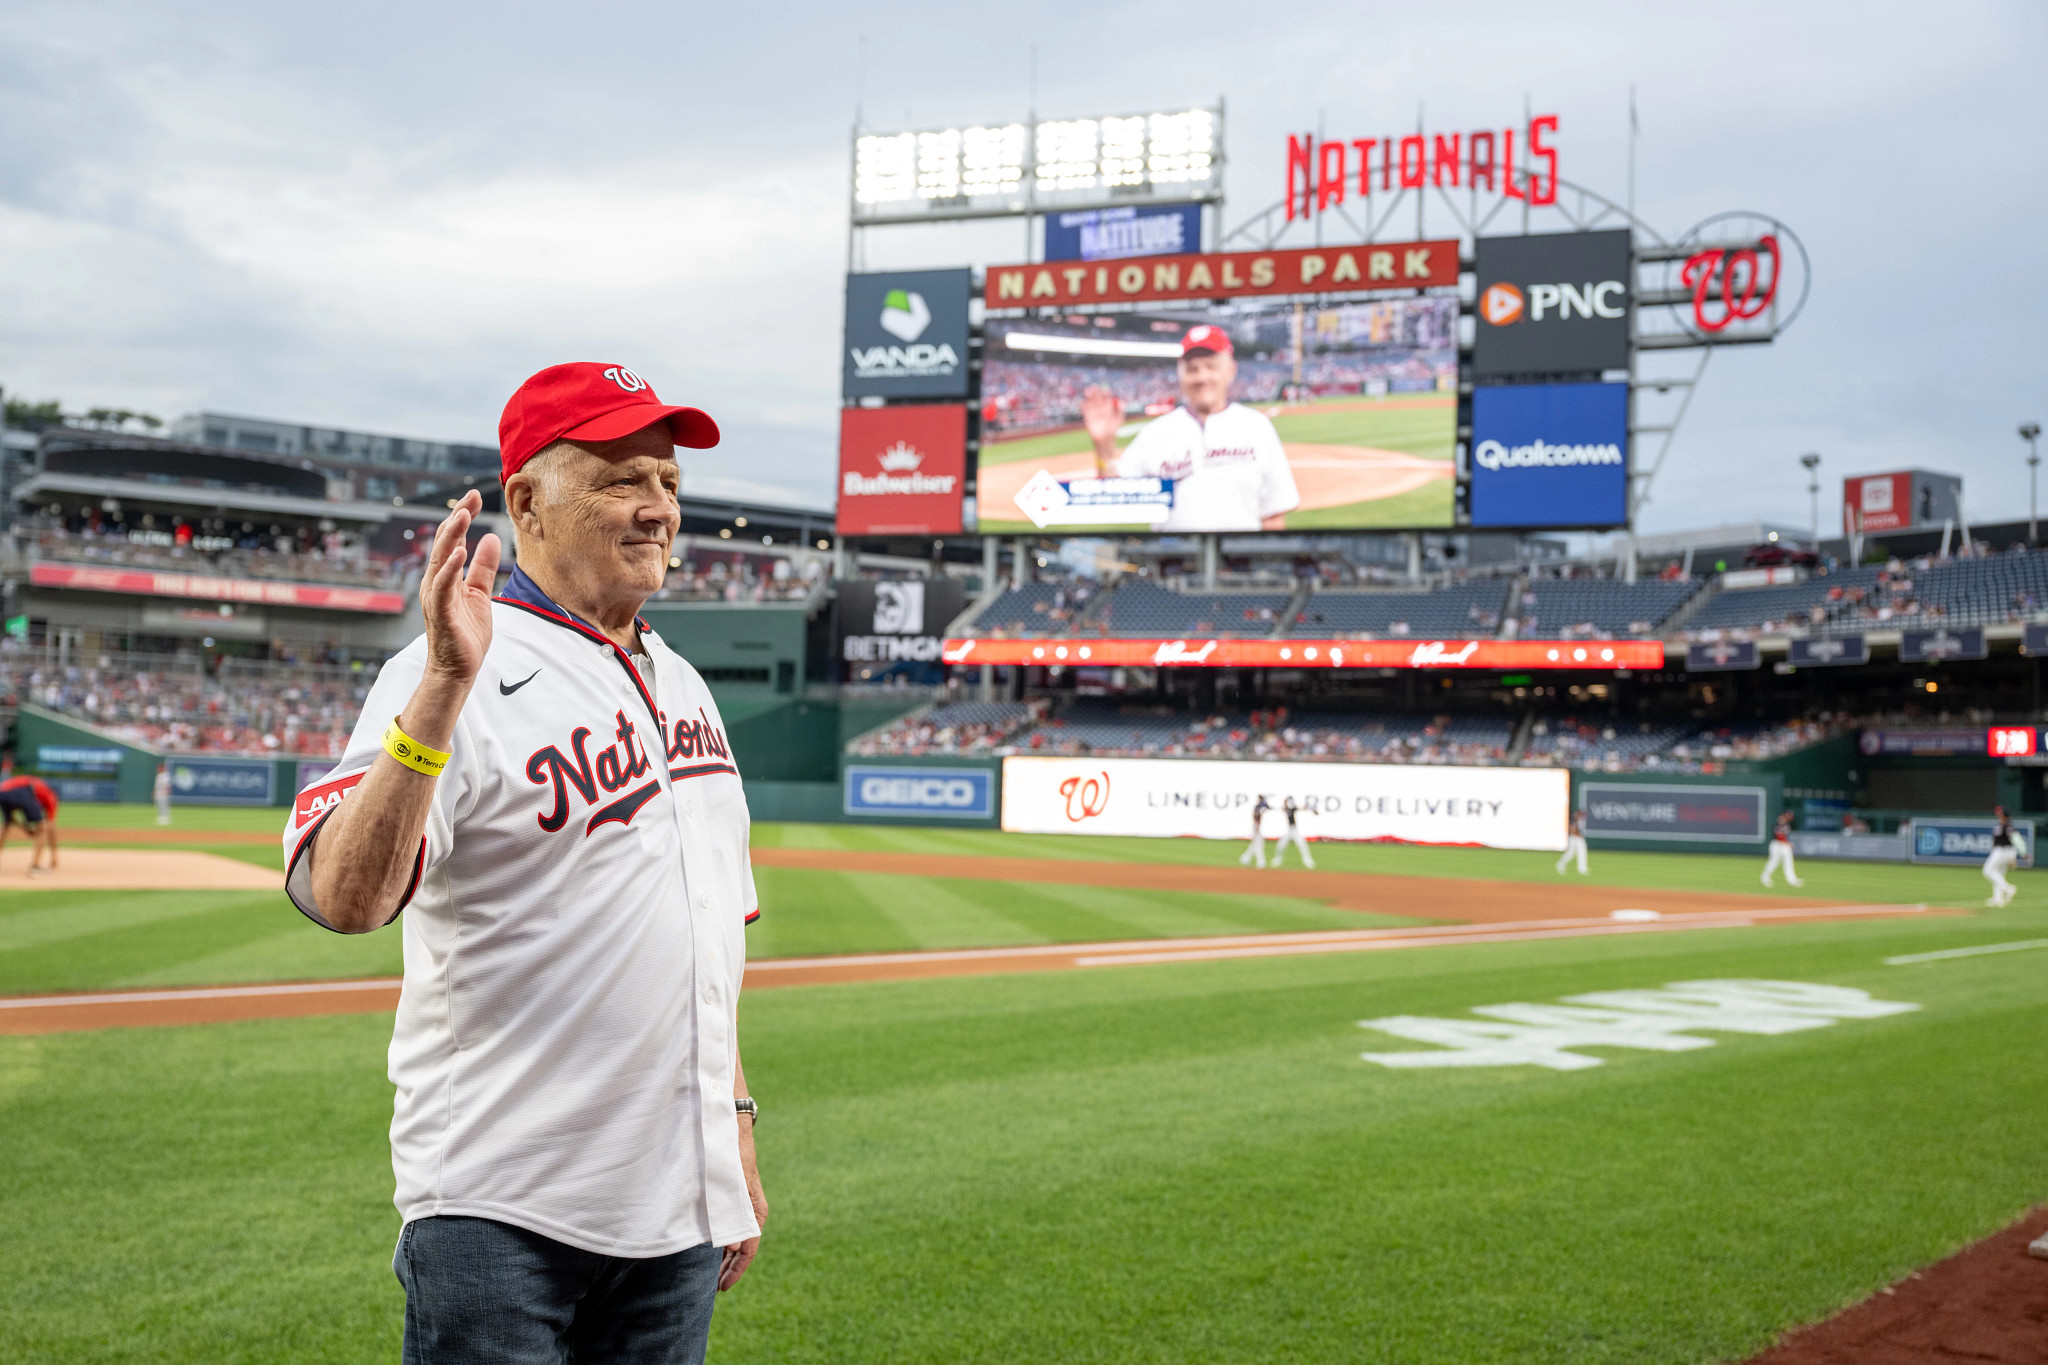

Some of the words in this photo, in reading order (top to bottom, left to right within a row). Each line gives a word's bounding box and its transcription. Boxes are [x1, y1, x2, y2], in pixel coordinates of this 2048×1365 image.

[1286, 115, 1559, 221] NATIONALS
[999, 258, 1276, 300] NATIONALS
[1301, 248, 1432, 285] PARK
[1527, 280, 1626, 322] PNC
[850, 343, 960, 369] VANDA
[603, 366, 647, 393] W
[1475, 439, 1623, 471] Qualcomm
[843, 471, 957, 496] Budweiser
[861, 777, 975, 806] GEICO
[1147, 791, 1249, 810] LINEUP
[1355, 795, 1504, 818] DELIVERY
[1589, 801, 1677, 823] VENTURE
